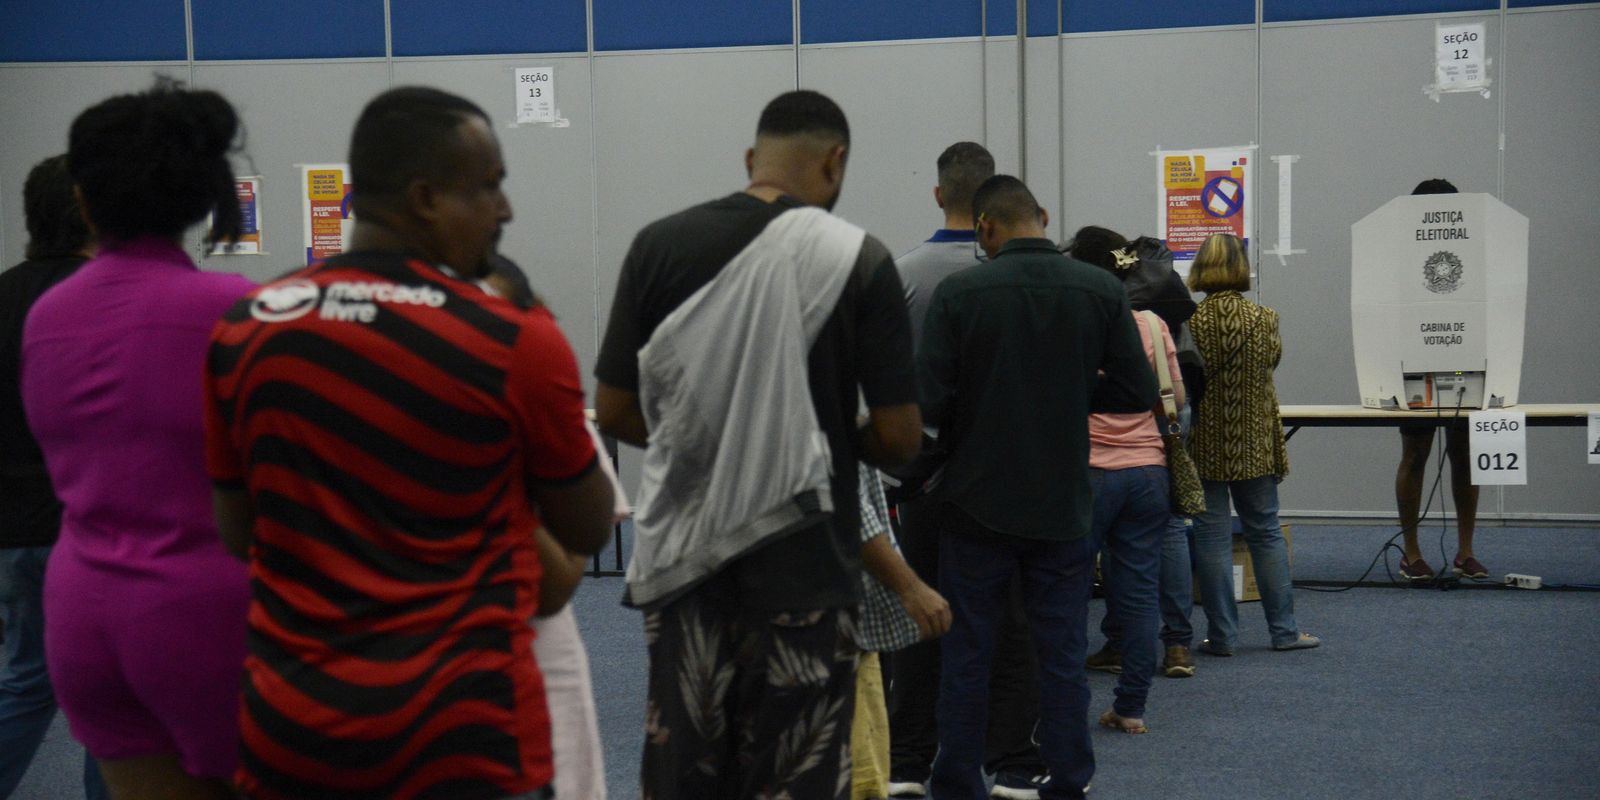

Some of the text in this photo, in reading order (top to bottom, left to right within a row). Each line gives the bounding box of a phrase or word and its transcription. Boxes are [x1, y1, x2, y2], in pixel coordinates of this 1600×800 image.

[1444, 32, 1478, 44] SEÇÃO
[1454, 49, 1468, 60] 12
[520, 72, 548, 83] SEÇÃO
[529, 88, 541, 98] 13
[1422, 211, 1464, 225] JUSTIÇA
[1416, 228, 1469, 240] ELEITORAL
[326, 282, 446, 308] mercado
[320, 301, 378, 322] livre
[1420, 322, 1464, 332] CABINA DE
[1424, 336, 1462, 346] VOTAÇÃO
[1476, 419, 1519, 434] SEÇÃO
[1477, 453, 1519, 470] 012
